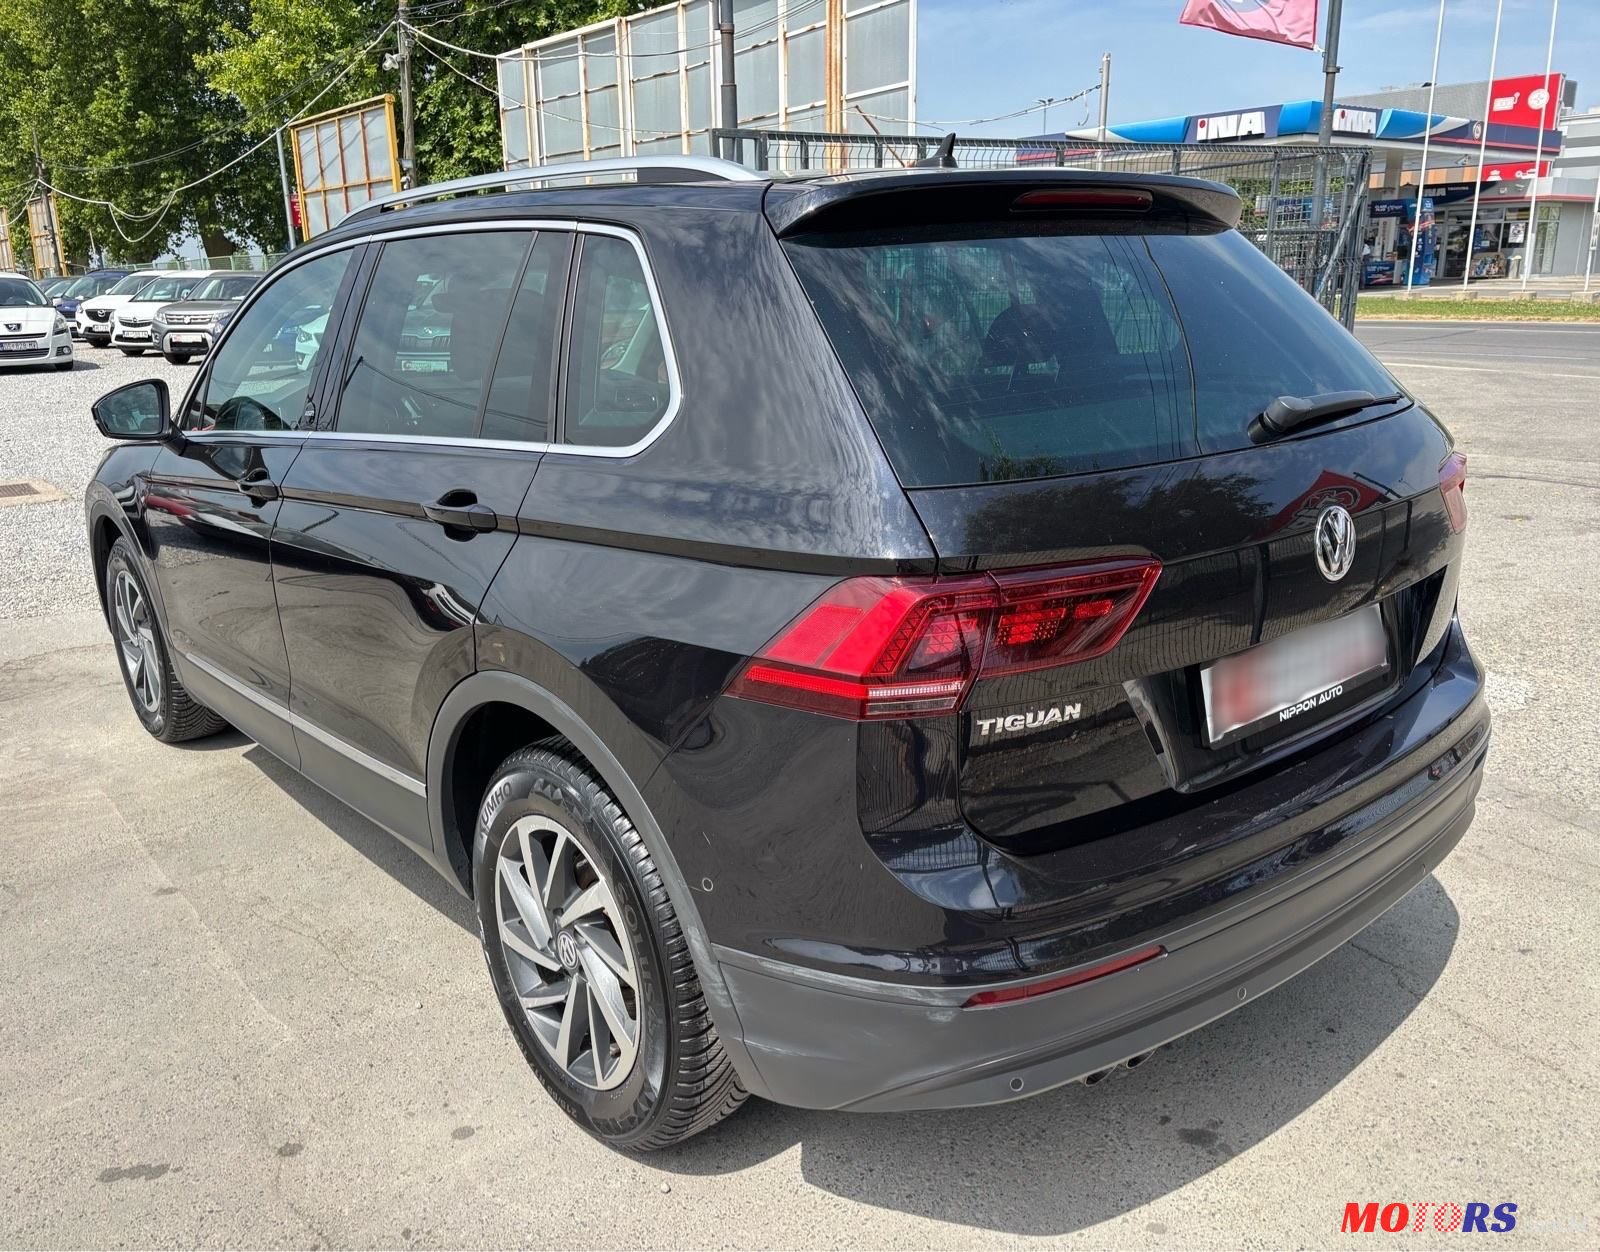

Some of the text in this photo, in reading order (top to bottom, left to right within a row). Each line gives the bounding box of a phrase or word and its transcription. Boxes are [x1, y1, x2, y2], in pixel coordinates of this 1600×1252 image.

[1197, 111, 1265, 141] INA
[976, 702, 1082, 736] TIGUAN
[1279, 685, 1343, 722] NIPPON AUTO
[480, 781, 511, 840] KUMHO
